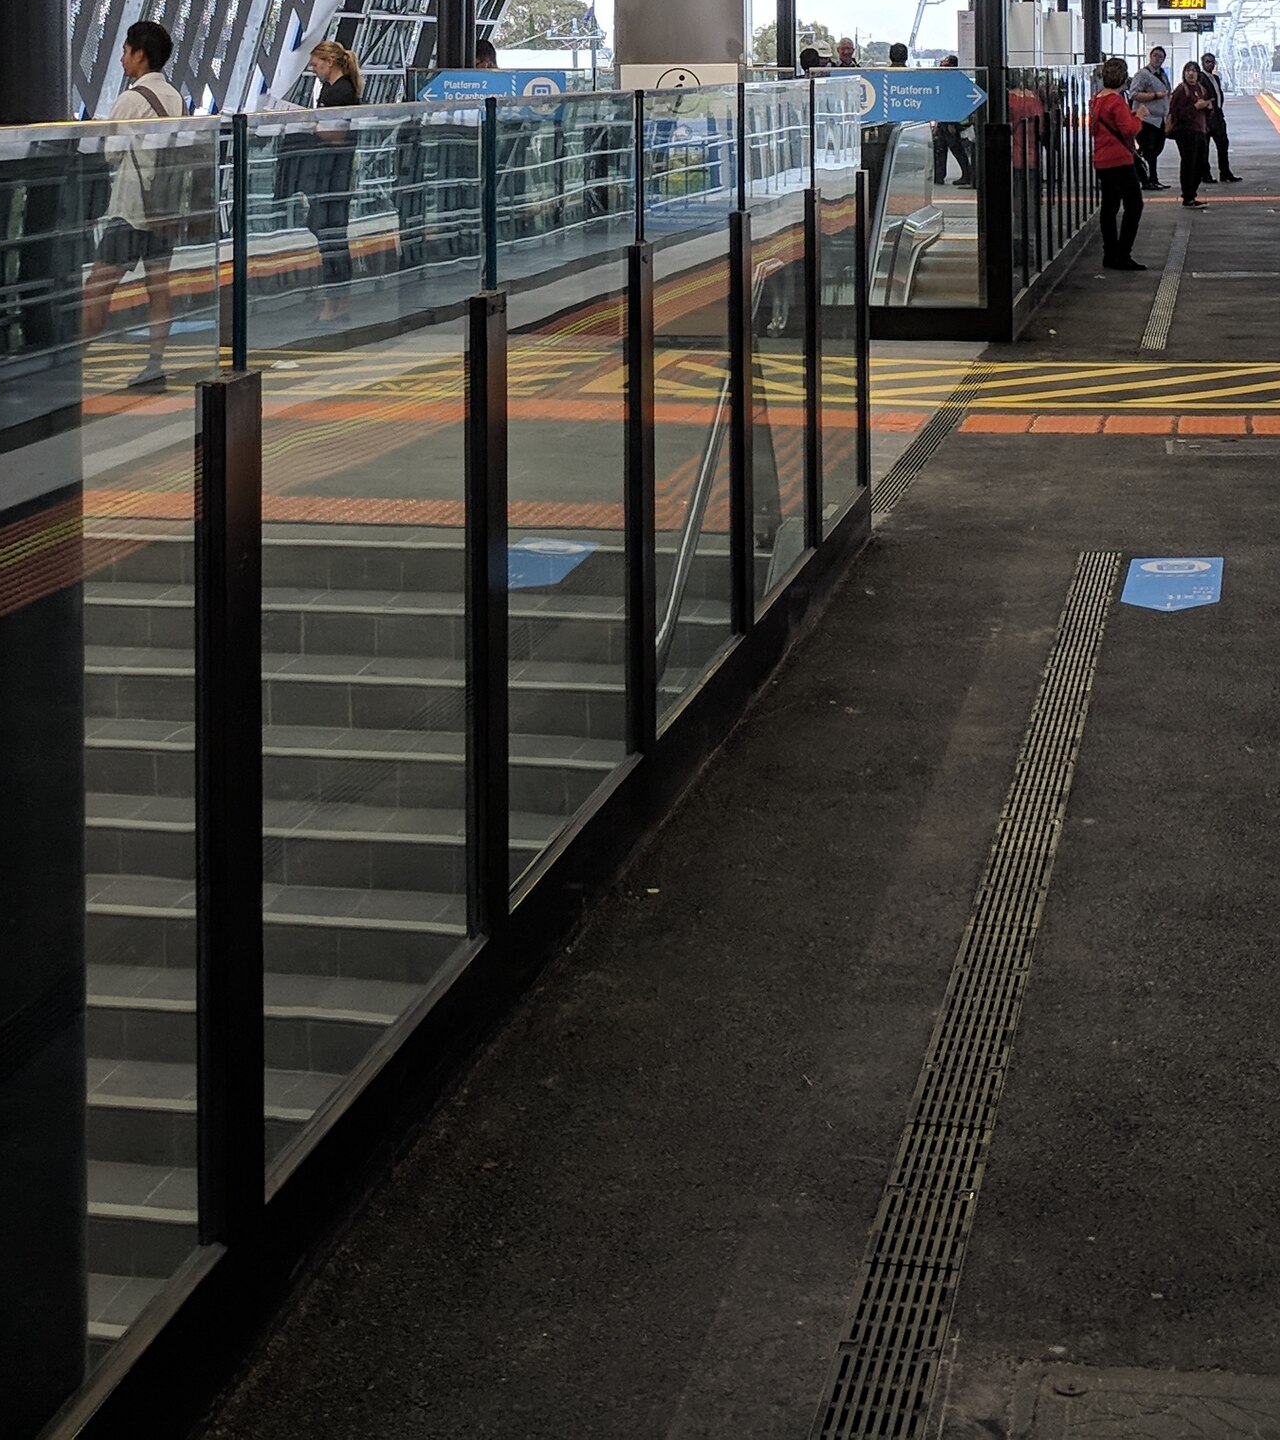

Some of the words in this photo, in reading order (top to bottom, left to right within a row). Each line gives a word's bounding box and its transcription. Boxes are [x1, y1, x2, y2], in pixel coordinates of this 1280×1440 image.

[443, 80, 480, 89] Platform
[482, 80, 488, 89] 2
[890, 85, 933, 95] Platform
[935, 85, 940, 95] 1
[443, 91, 453, 100] To
[890, 98, 902, 108] To
[903, 98, 922, 109] City
